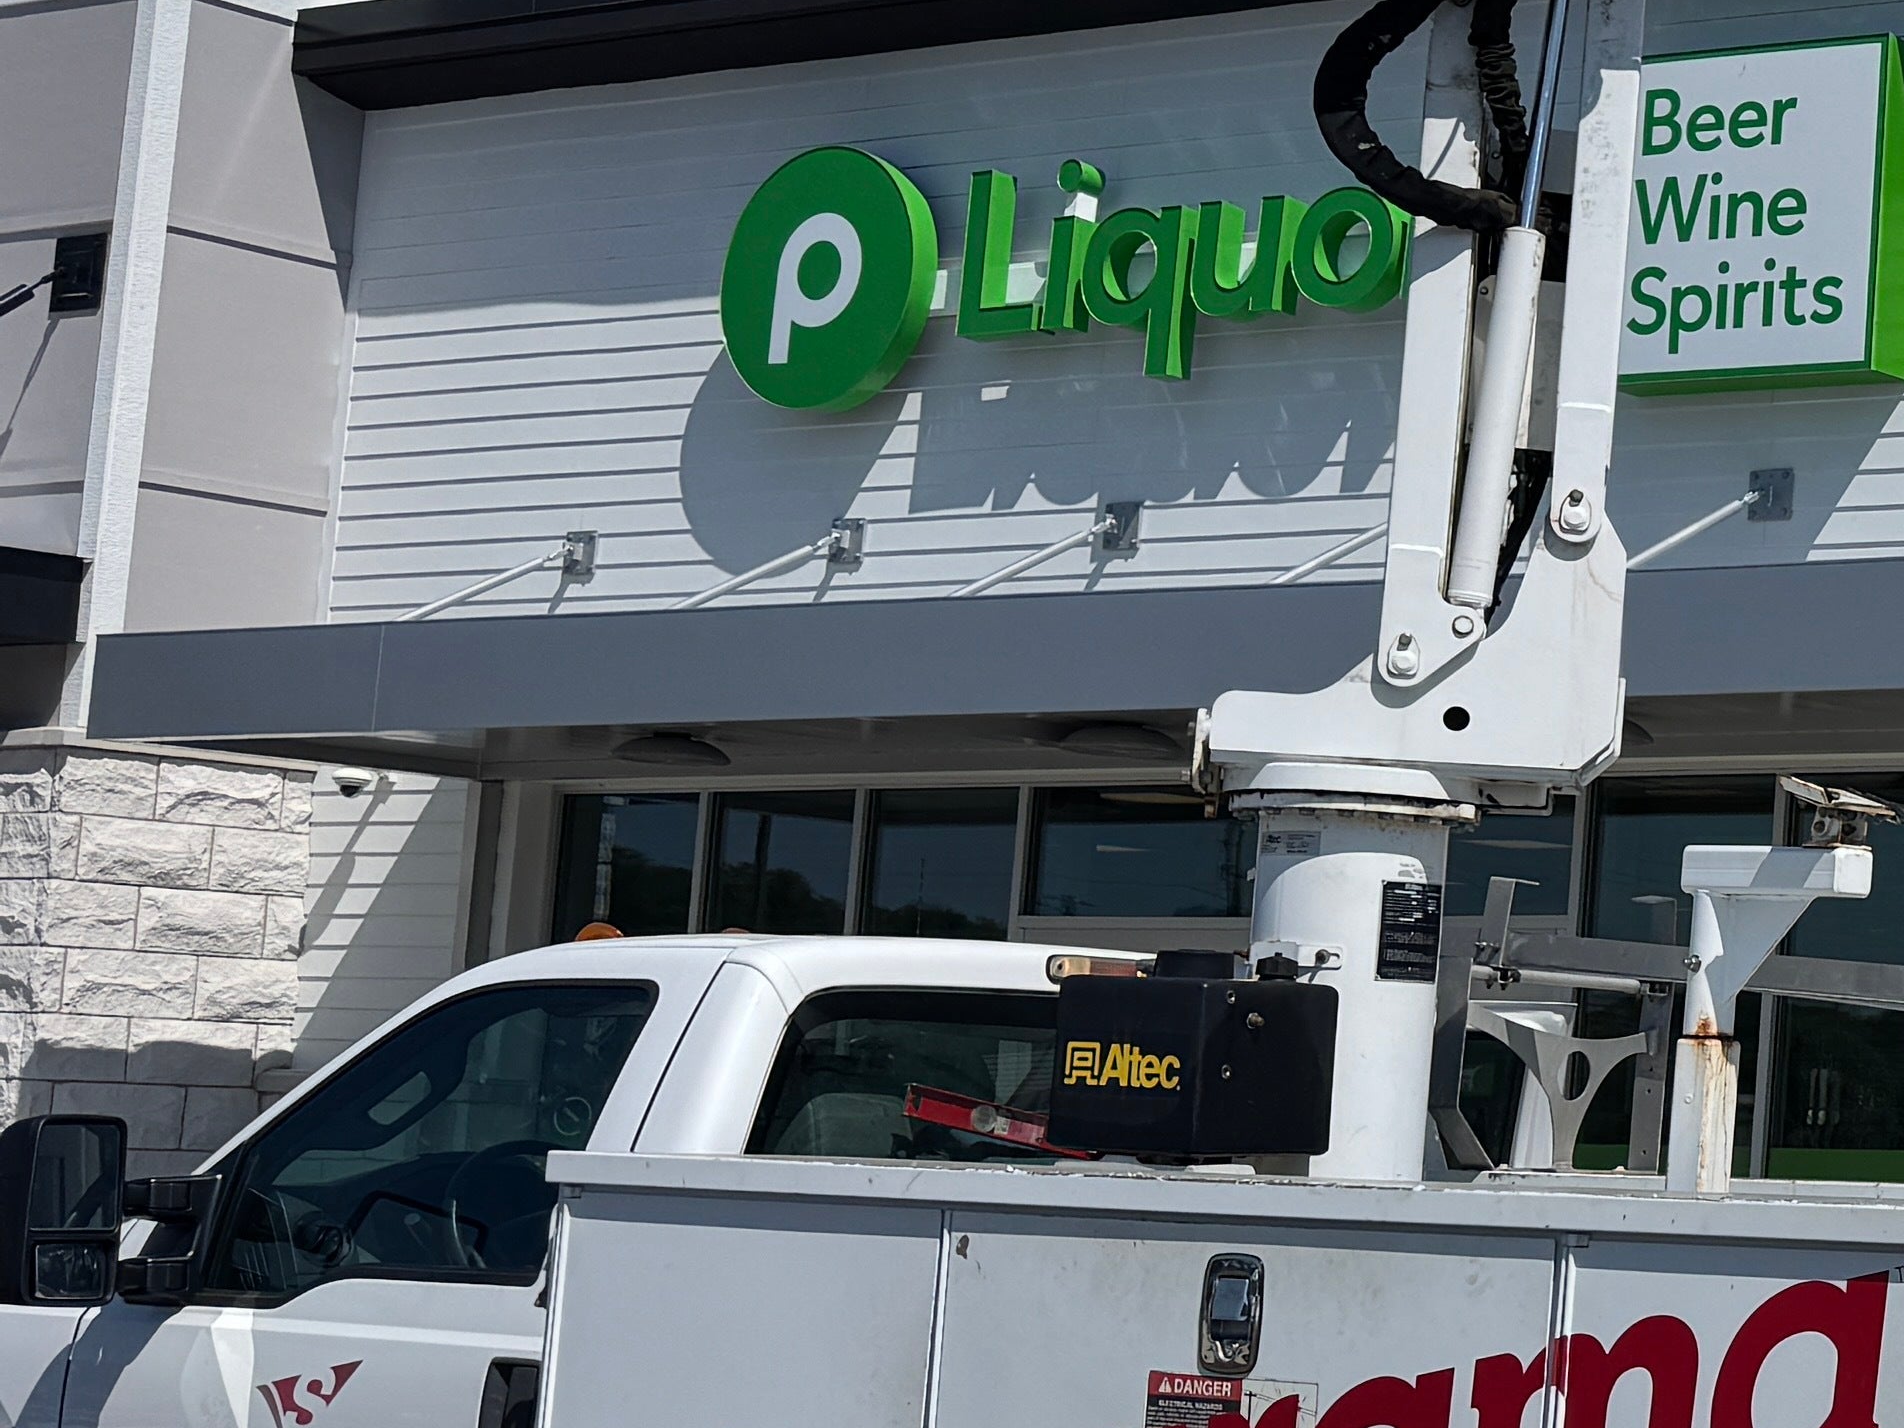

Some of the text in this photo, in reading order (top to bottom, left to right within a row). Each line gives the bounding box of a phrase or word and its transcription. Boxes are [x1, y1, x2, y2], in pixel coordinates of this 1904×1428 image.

[1641, 88, 1800, 158] Beer
[1635, 174, 1809, 247] Wine
[956, 159, 1415, 378] Liquo
[1626, 259, 1846, 356] Spirits
[1099, 1043, 1181, 1090] Altec
[1173, 1377, 1232, 1397] DANGER
